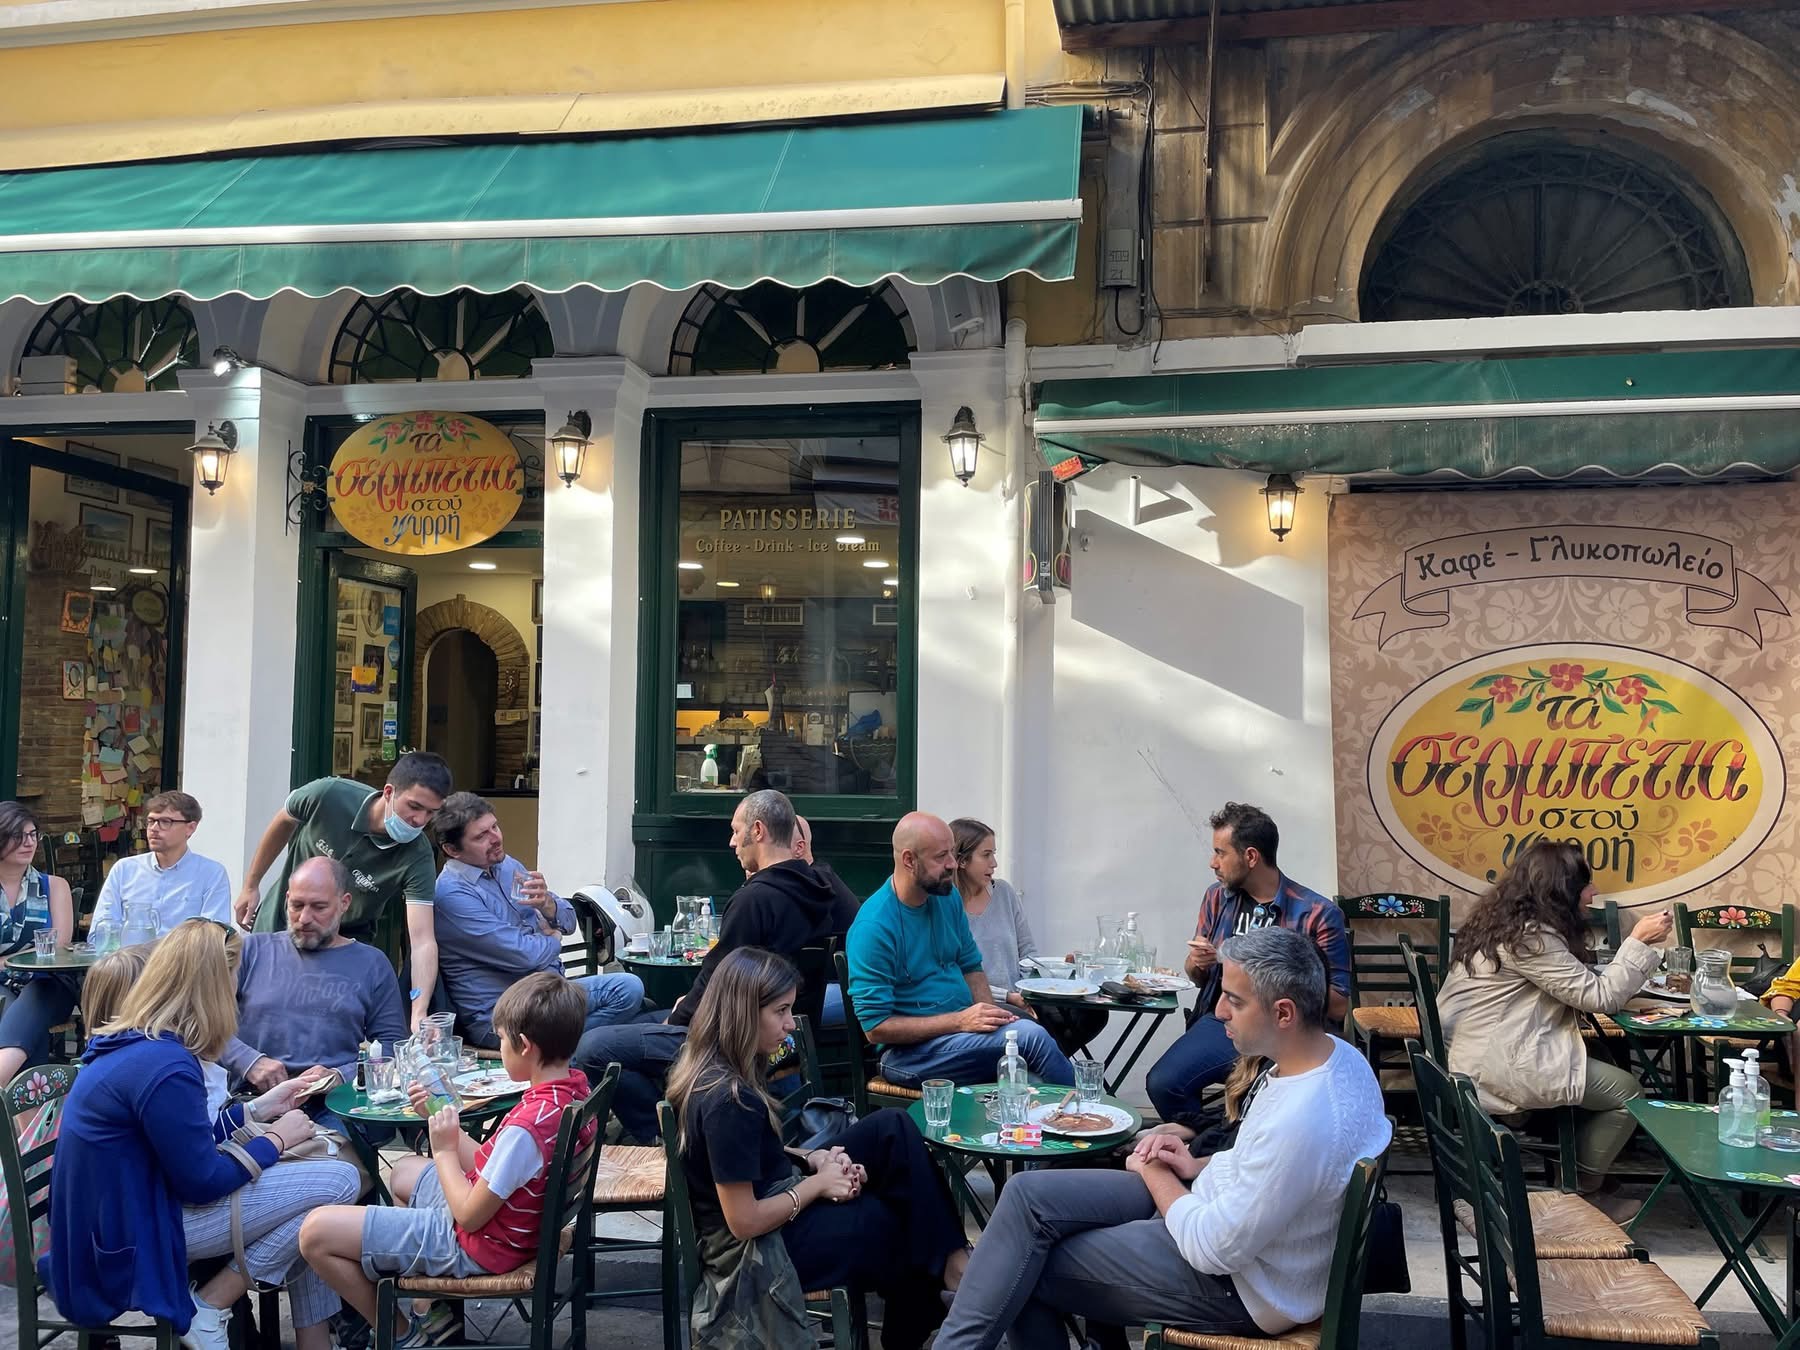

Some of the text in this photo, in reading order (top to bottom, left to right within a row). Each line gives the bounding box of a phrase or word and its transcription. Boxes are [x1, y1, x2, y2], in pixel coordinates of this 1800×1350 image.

[719, 508, 856, 530] PATISSERIE
[695, 538, 741, 553] Coffee
[754, 539, 794, 553] Drink
[808, 538, 829, 553] Ice
[836, 541, 880, 553] cream
[1415, 541, 1496, 580] Καφέ
[1529, 535, 1724, 580] Γλυκοπωλείο
